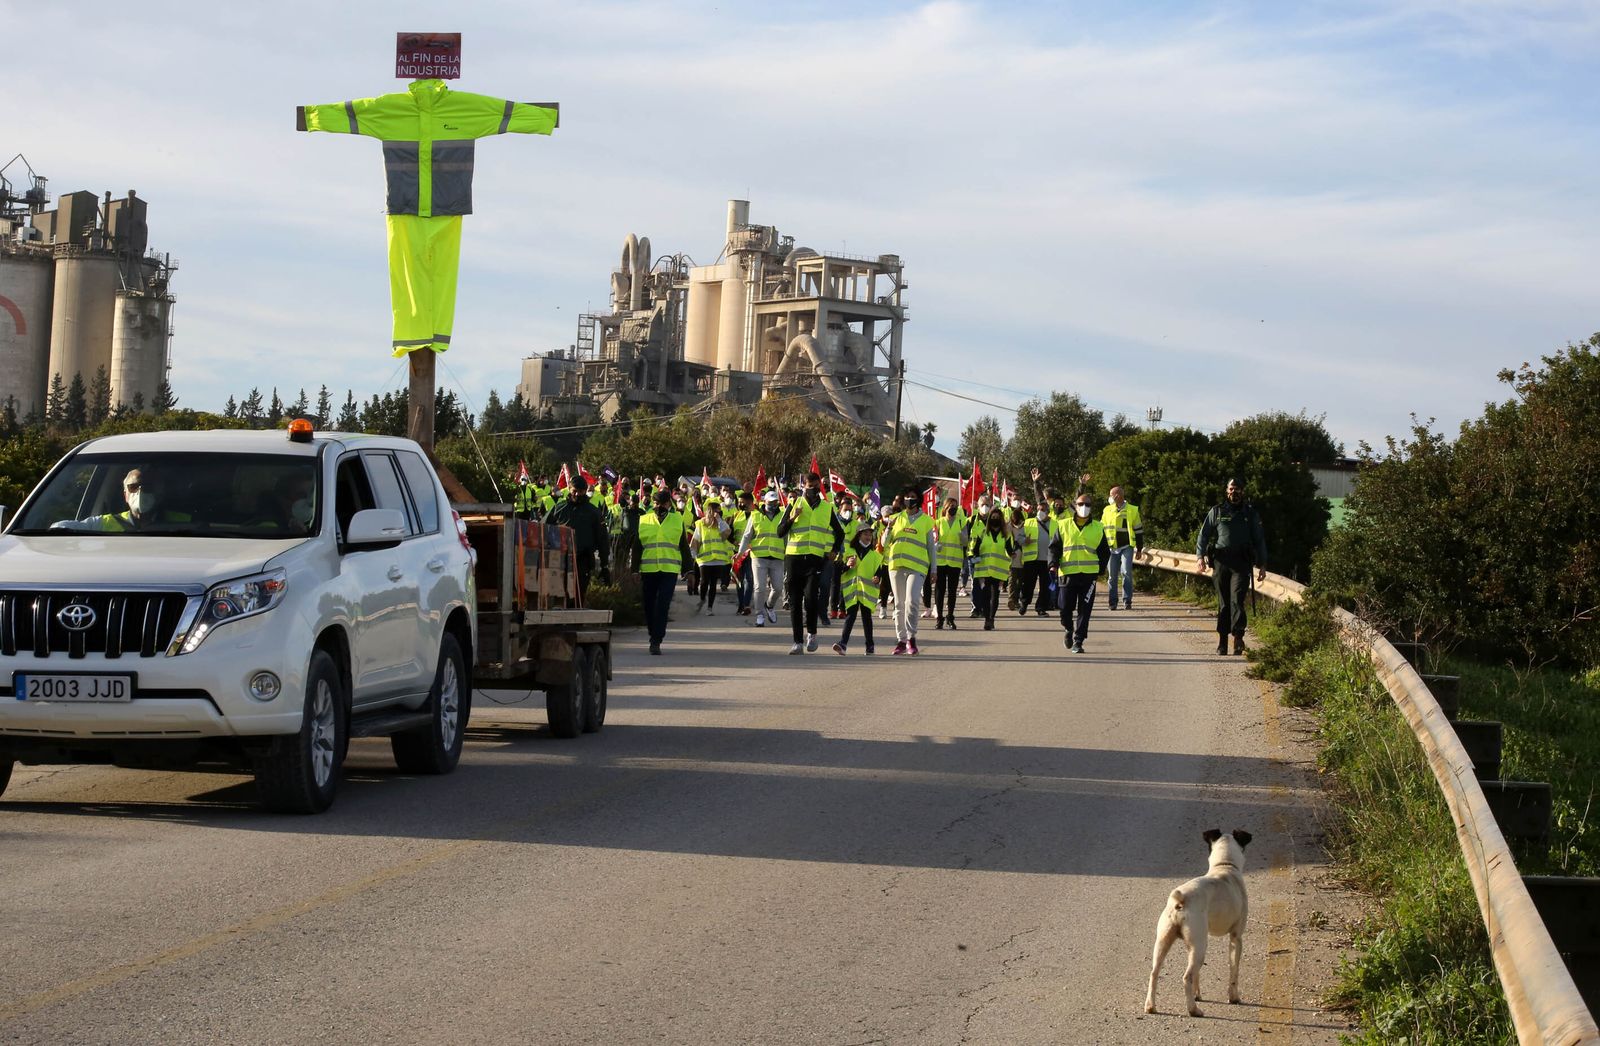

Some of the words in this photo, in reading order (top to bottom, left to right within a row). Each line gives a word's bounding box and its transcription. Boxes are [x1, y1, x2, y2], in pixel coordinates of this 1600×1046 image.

[399, 55, 409, 63] AL
[412, 53, 431, 63] FIN
[434, 55, 447, 63] DE
[449, 55, 460, 63] LA
[397, 65, 460, 76] INDUSTRIA
[29, 679, 79, 698] 2003
[87, 679, 124, 698] JJD
